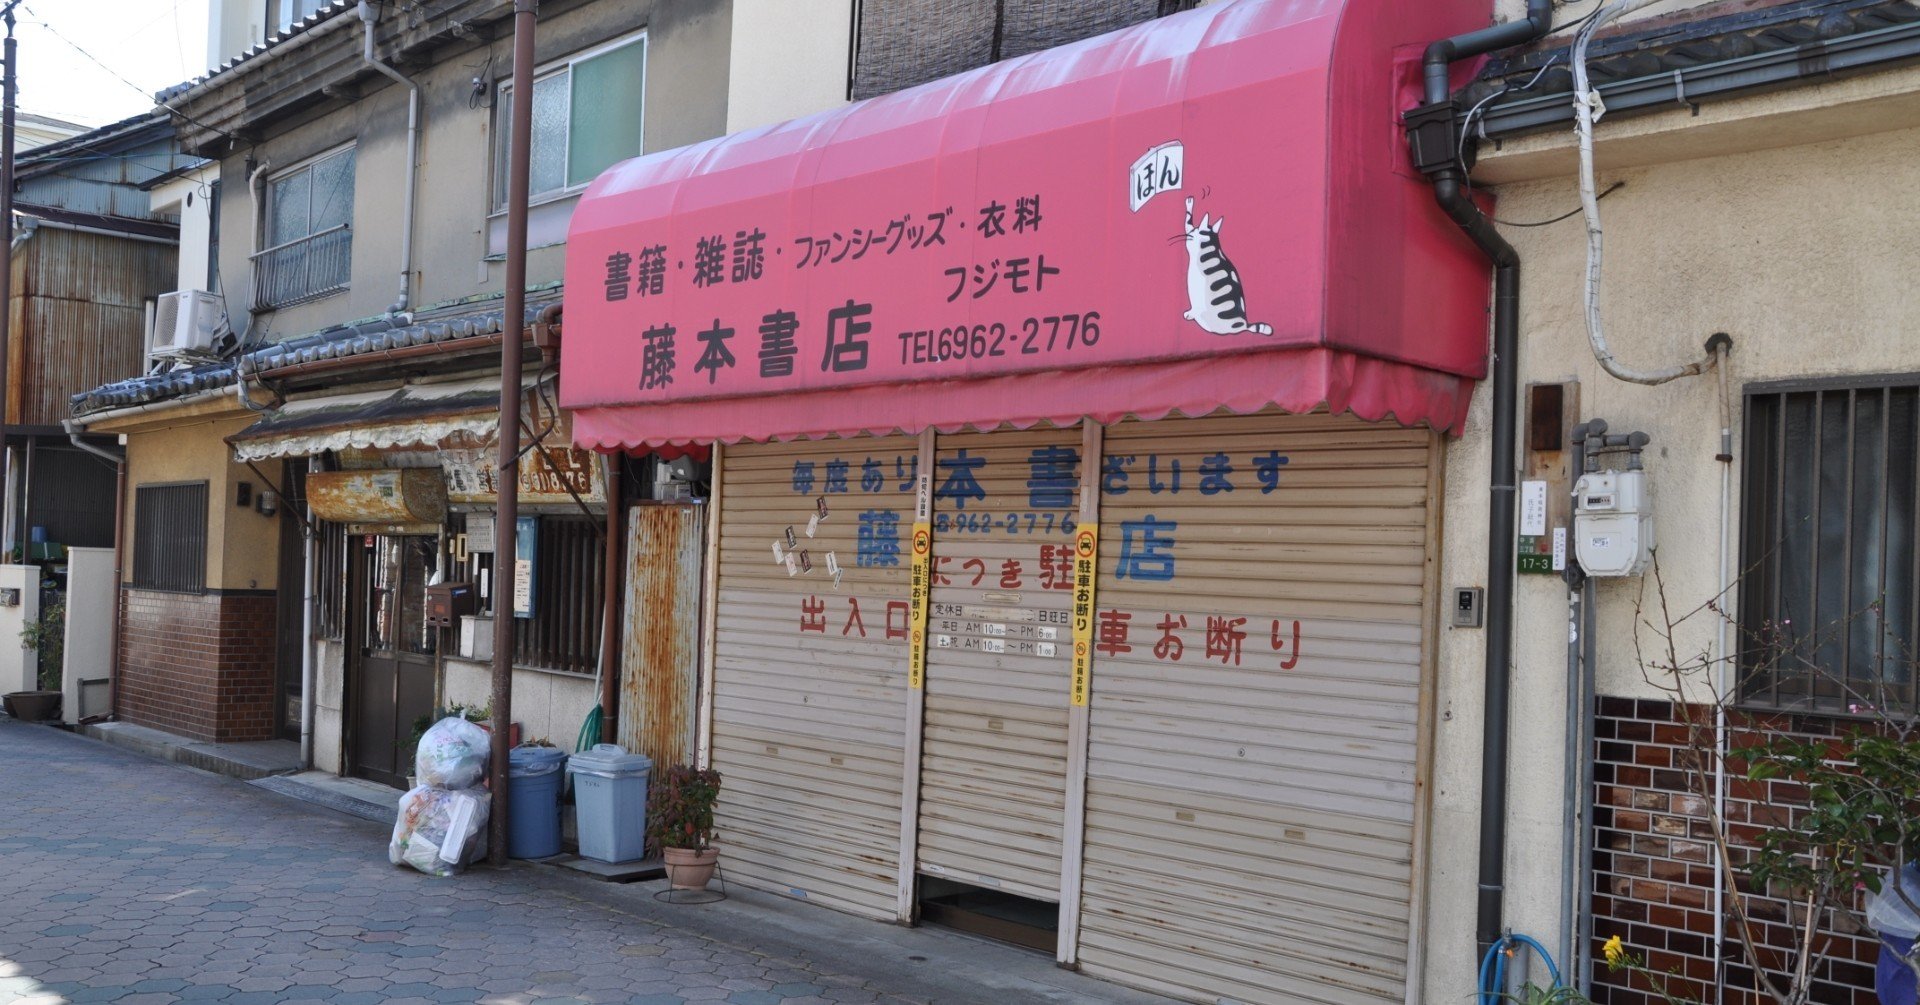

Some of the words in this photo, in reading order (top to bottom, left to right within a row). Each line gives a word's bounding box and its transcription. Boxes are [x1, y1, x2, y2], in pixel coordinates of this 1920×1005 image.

[1137, 155, 1179, 201] ほん
[944, 255, 1060, 303] フジモト
[639, 299, 873, 391] 藤本書店
[1115, 514, 1178, 581] 店
[1522, 558, 1549, 570] 17-3
[912, 564, 922, 621] 駐車お断り
[935, 605, 962, 616] 定休日
[1076, 560, 1091, 631] 駐車お断り
[800, 595, 910, 640] 出入口
[942, 621, 958, 631] 平日
[966, 622, 980, 633] AM
[1020, 626, 1034, 637] PM
[1096, 609, 1300, 670] 車お断り
[965, 639, 980, 649] AM
[1020, 642, 1034, 653] PM
